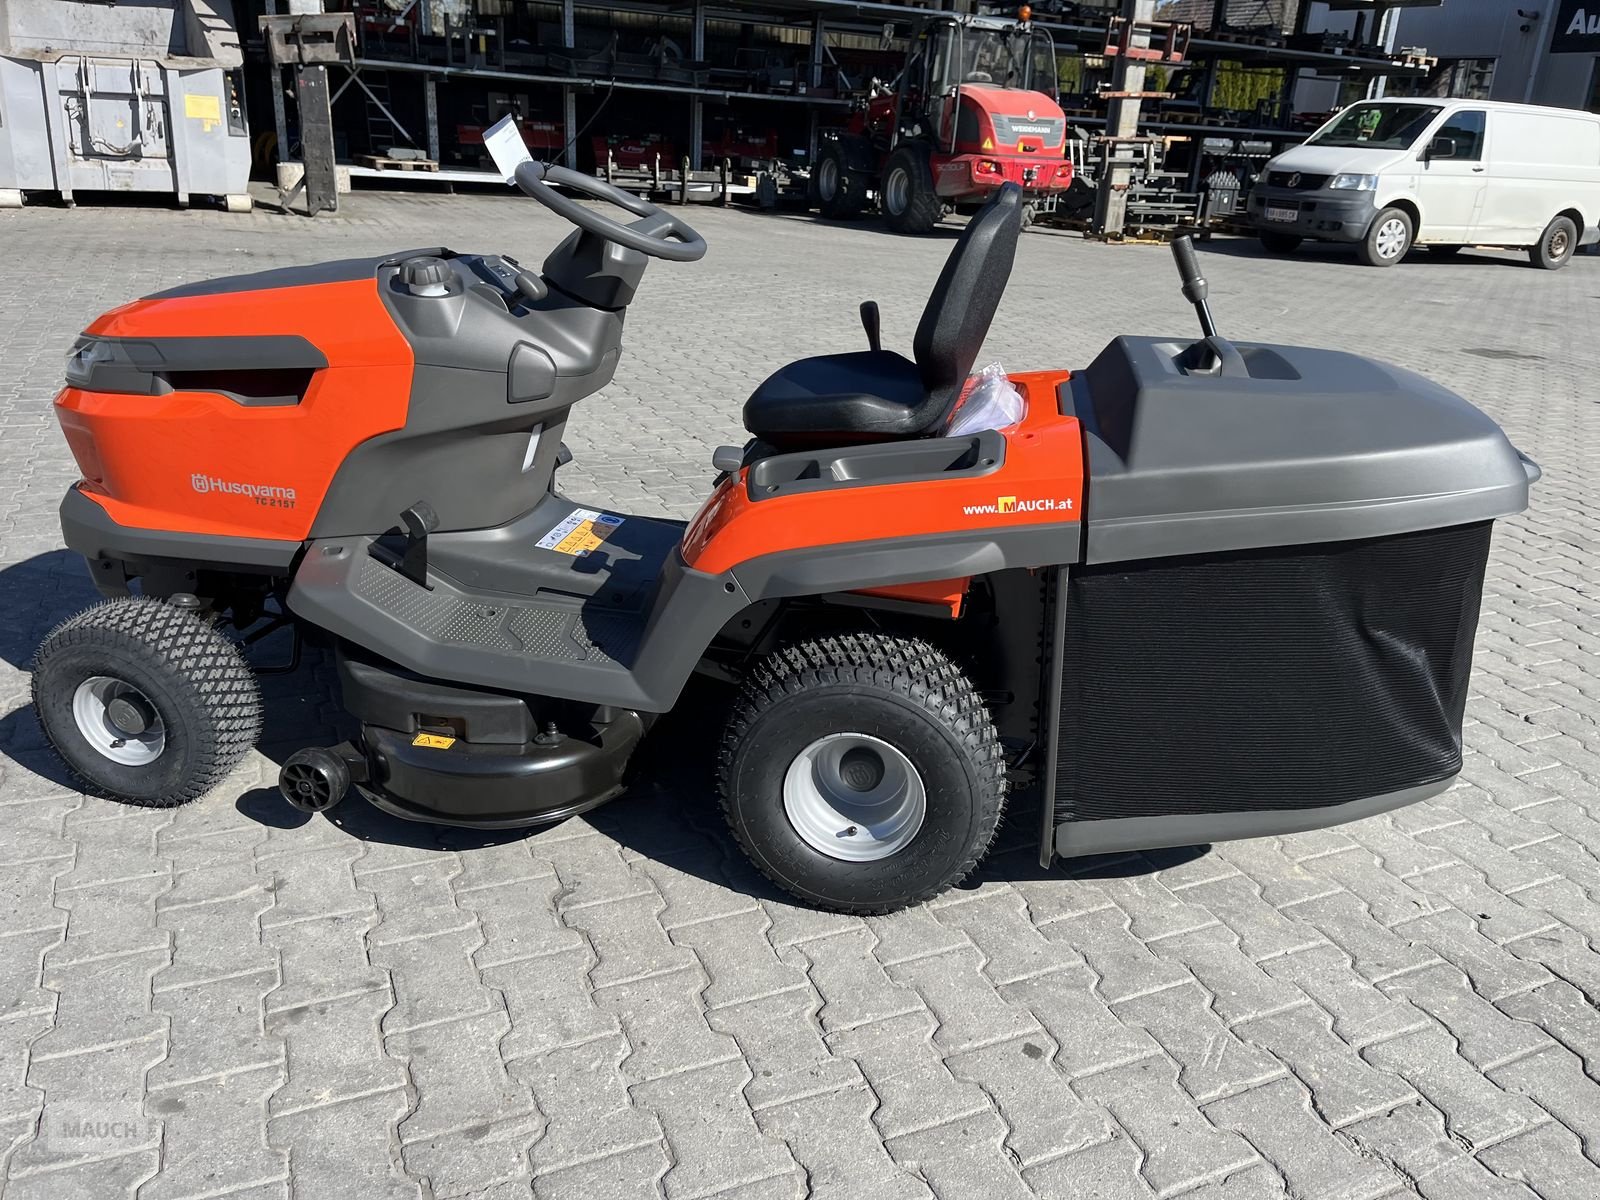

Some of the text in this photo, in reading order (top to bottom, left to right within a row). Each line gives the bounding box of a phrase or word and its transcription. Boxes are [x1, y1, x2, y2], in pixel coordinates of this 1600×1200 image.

[1011, 125, 1051, 134] WEIDEMANN
[209, 477, 296, 499] Husqvarna
[255, 497, 296, 509] TC 215T
[962, 498, 1073, 515] www.MAUCH.at
